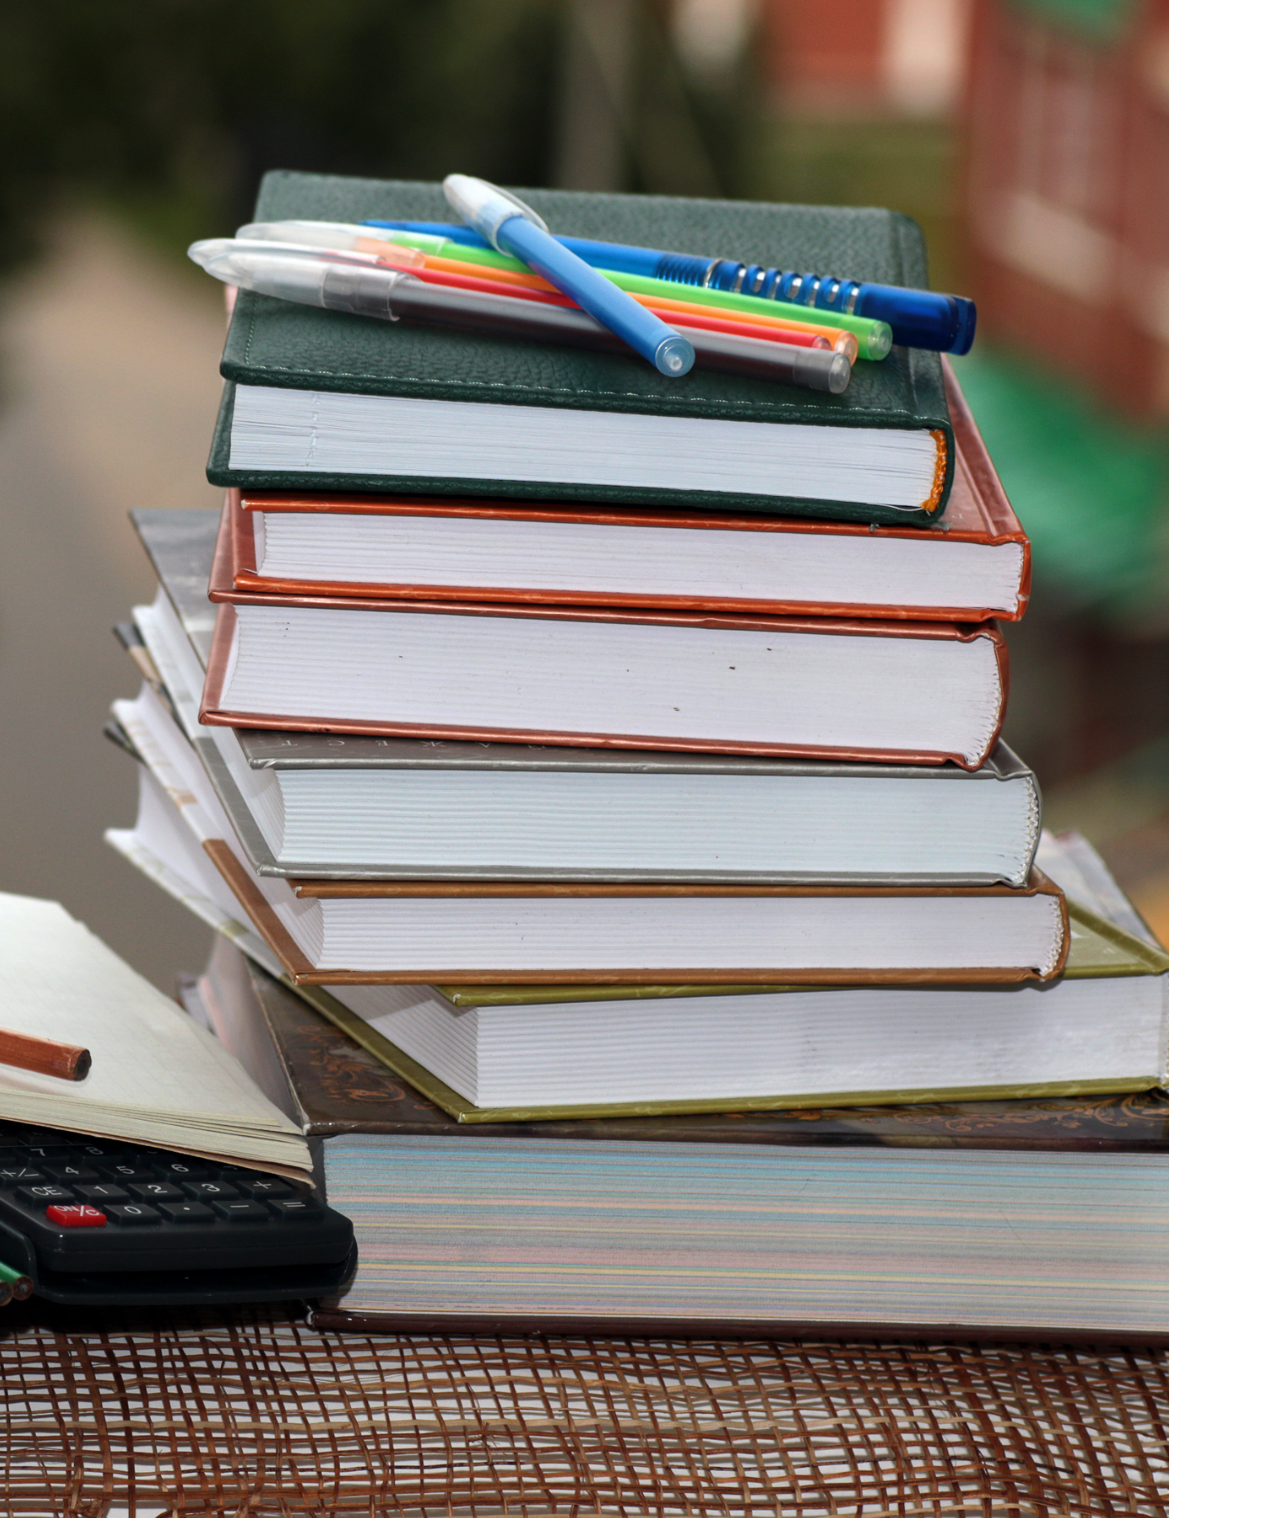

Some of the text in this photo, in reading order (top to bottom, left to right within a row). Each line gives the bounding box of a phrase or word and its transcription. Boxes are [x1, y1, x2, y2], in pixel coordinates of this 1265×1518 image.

[30, 1148, 46, 1157] 7
[84, 1146, 104, 1156] 8
[65, 1166, 80, 1175] 4
[116, 1165, 135, 1175] 5
[171, 1163, 190, 1173] 6
[31, 1186, 63, 1196] CE
[94, 1185, 109, 1194] 1
[147, 1184, 168, 1194] 2
[201, 1183, 221, 1192] 3
[123, 1205, 142, 1215] 0
